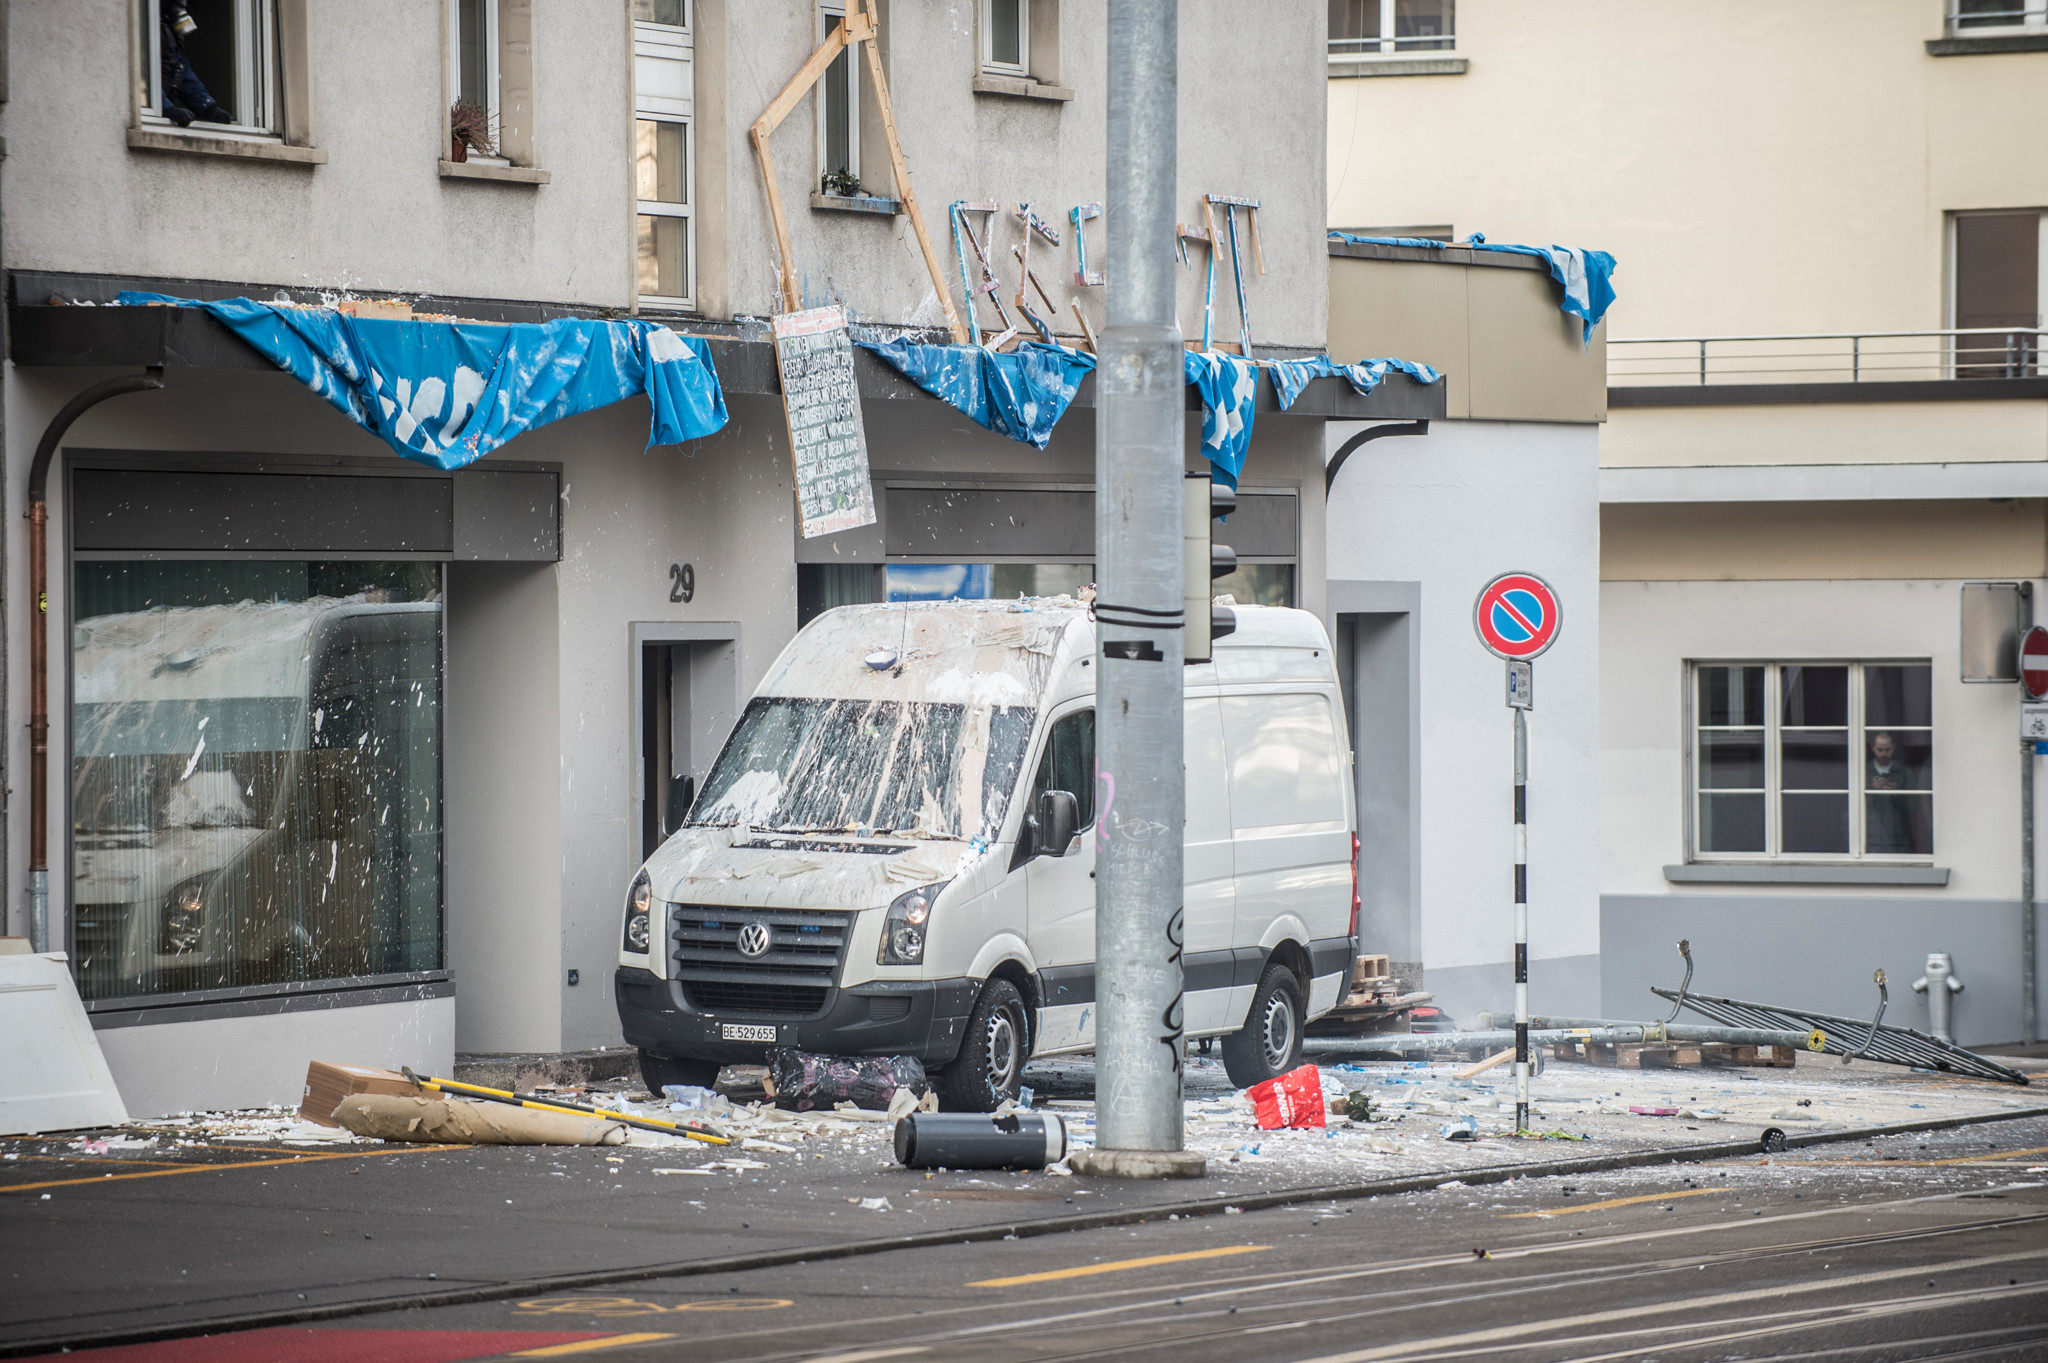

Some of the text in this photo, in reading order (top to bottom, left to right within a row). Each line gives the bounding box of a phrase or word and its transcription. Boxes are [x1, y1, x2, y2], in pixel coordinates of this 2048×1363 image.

[669, 563, 695, 604] 29
[738, 922, 770, 957] VW
[1273, 1081, 1290, 1126] DENNER
